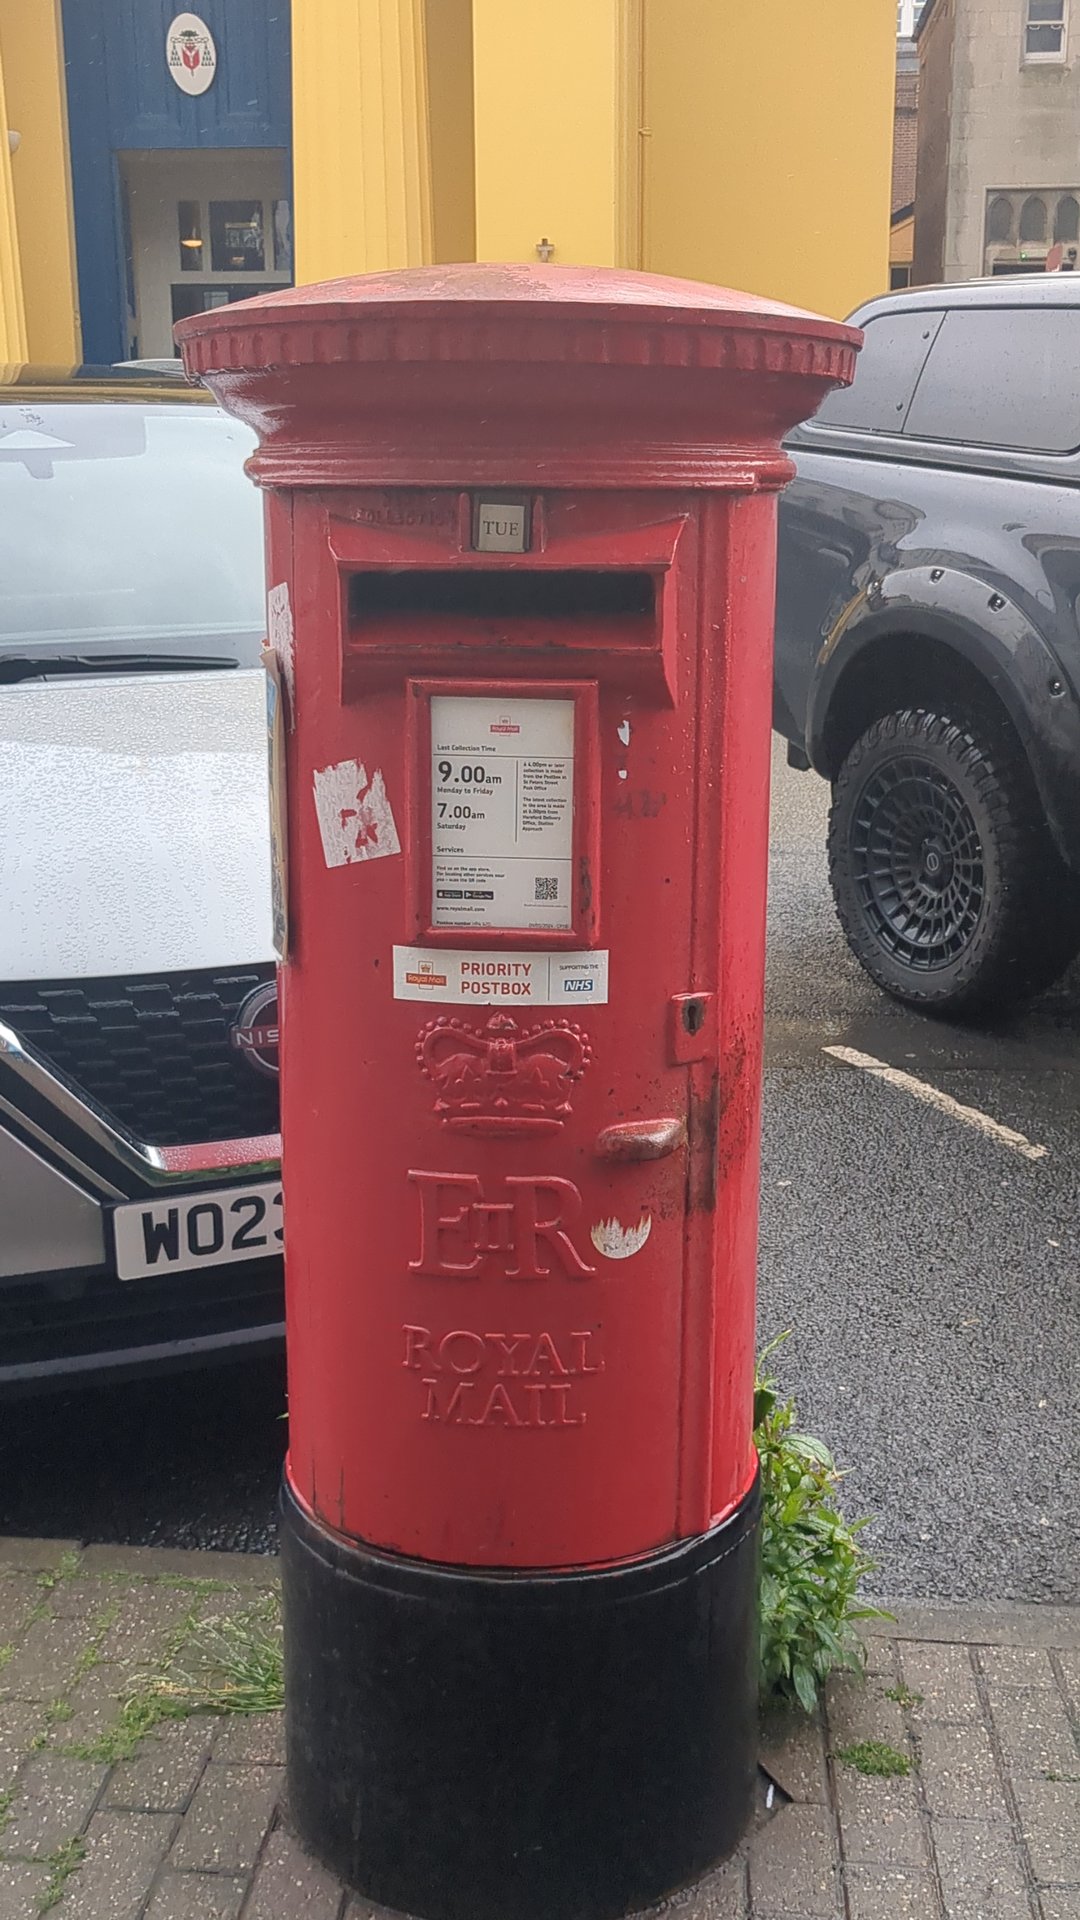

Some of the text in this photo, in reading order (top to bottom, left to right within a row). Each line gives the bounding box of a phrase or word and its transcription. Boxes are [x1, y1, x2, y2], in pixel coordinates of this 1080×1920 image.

[483, 520, 519, 536] TUE
[451, 744, 480, 752] Collection
[438, 760, 502, 784] 9.00am
[437, 786, 463, 795] Monday
[473, 787, 494, 796] Friday
[437, 803, 485, 819] 7.00am
[437, 822, 466, 831] Saturday
[461, 962, 532, 976] PRIORITY
[408, 974, 445, 984] Royal Mail
[565, 980, 592, 991] NHS
[461, 981, 532, 996] POSTBOX
[141, 1191, 285, 1265] WO2
[402, 1324, 605, 1375] ROYAL
[421, 1378, 587, 1425] MAIL
